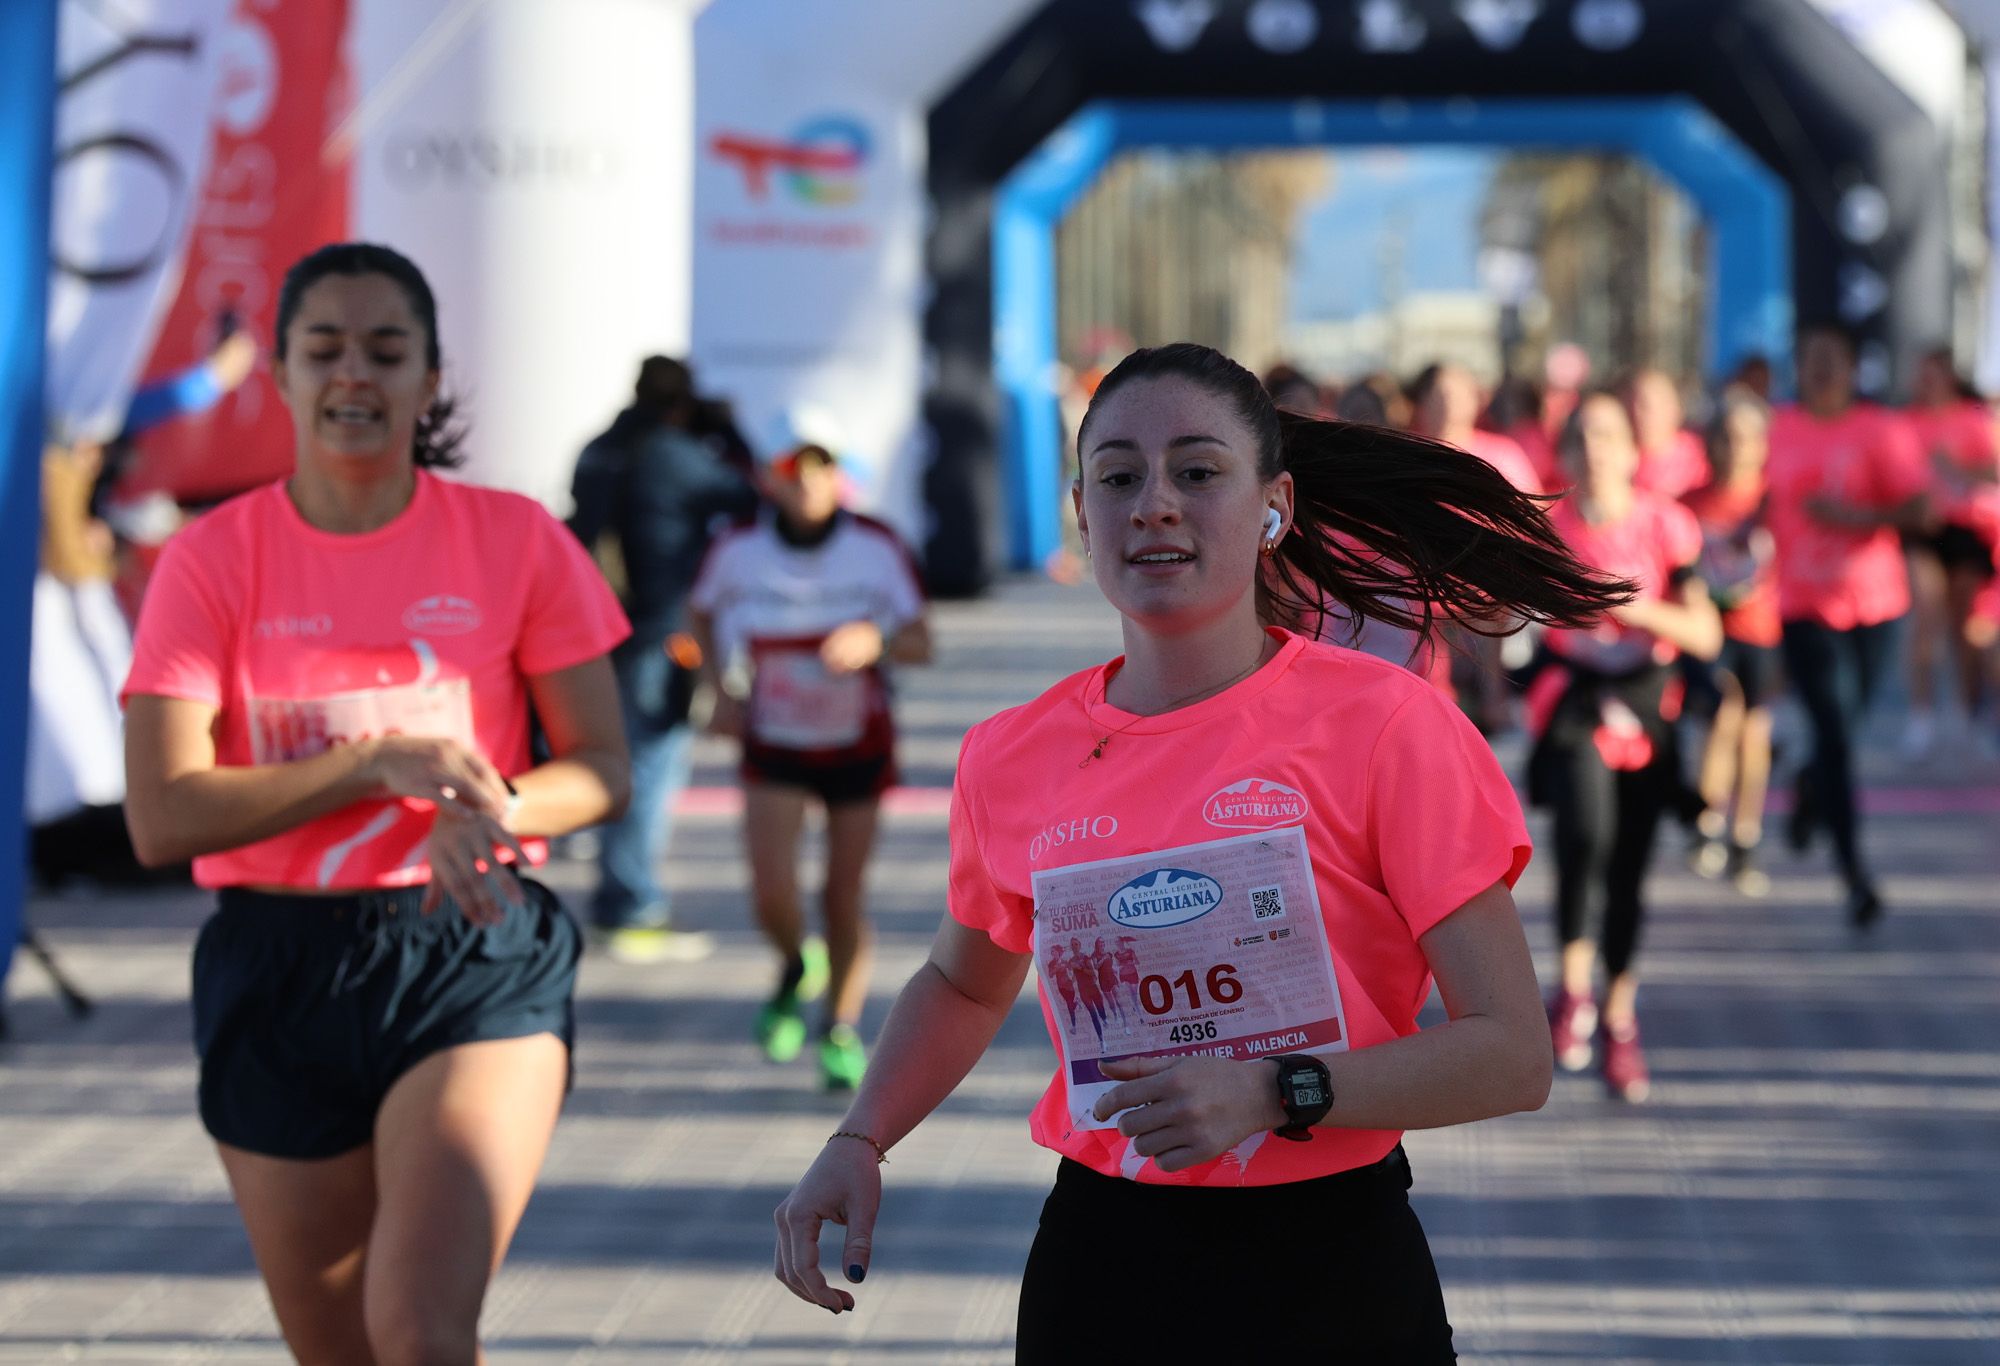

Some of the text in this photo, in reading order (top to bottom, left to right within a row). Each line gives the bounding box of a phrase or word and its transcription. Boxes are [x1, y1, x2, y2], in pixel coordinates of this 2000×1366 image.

[1211, 799, 1300, 820] ASTURIANA
[1029, 815, 1118, 861] OYSHO
[1131, 881, 1208, 900] CENTRAL LECHERA
[1061, 902, 1096, 916] DORSAL
[1117, 889, 1216, 920] ASTURIANA
[1052, 912, 1099, 934] SUMA
[1139, 963, 1244, 1015] 016
[1170, 1020, 1218, 1044] 4936
[1245, 1031, 1309, 1055] VALENCIA
